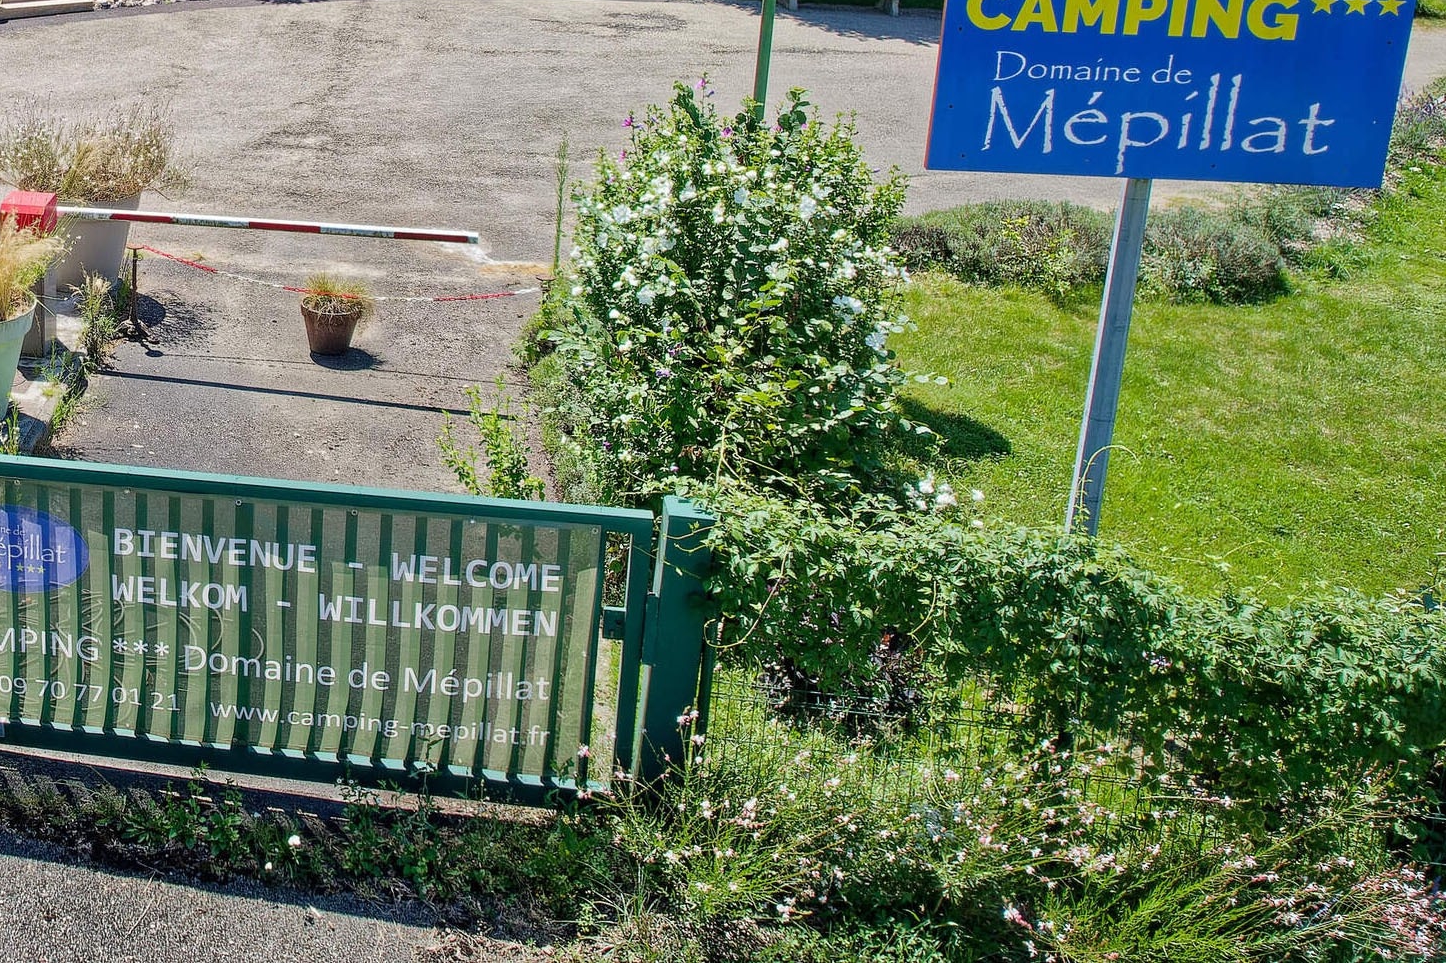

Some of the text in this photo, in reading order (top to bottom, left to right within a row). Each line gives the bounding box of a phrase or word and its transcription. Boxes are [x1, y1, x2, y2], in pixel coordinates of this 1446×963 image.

[993, 50, 1193, 85] Domaine de
[981, 73, 1336, 175] Mépillat
[12, 524, 26, 537] de
[113, 527, 317, 574] BIENVENUE
[391, 552, 561, 593] WELCOME
[111, 574, 248, 613] WELKOM
[318, 593, 557, 637] WILLKOMMEN
[184, 644, 337, 687] Domaine
[348, 661, 391, 691] de
[403, 666, 551, 704] Mépillat
[35, 679, 66, 700] 70
[73, 683, 104, 703] 77
[111, 686, 142, 706] 01
[149, 691, 181, 711] 21
[210, 701, 551, 747] www.camping-mepillat.fr
